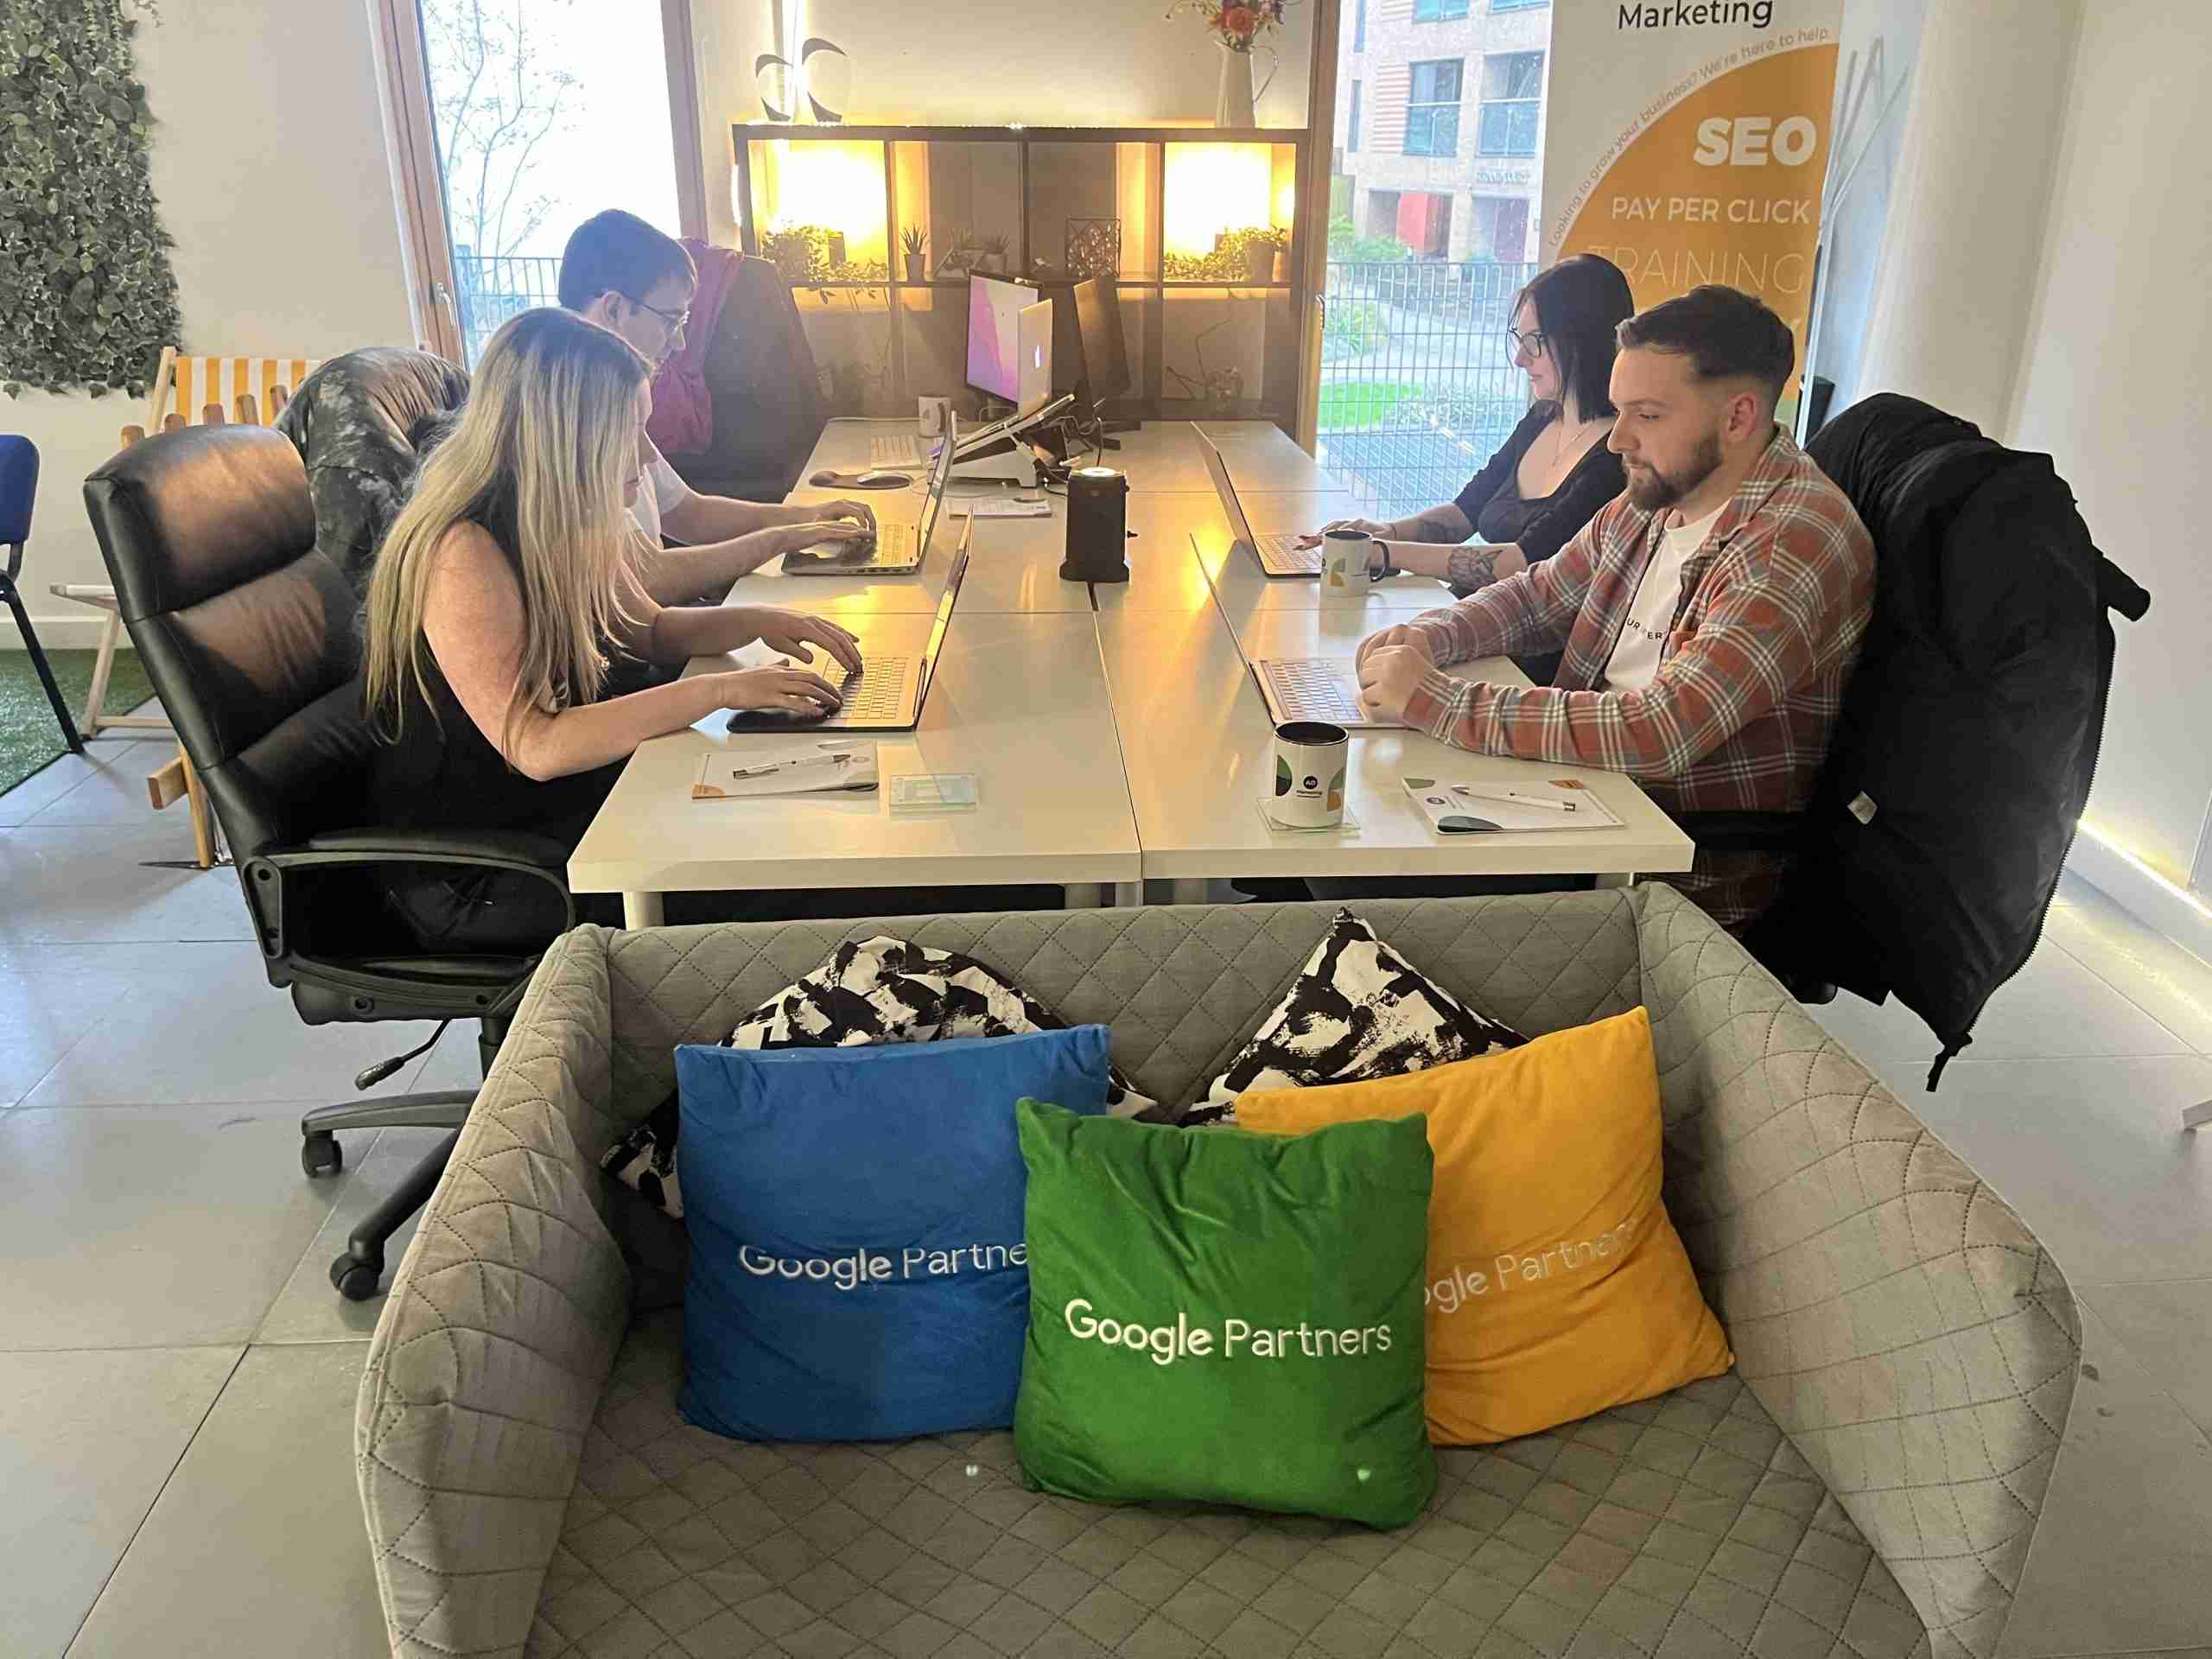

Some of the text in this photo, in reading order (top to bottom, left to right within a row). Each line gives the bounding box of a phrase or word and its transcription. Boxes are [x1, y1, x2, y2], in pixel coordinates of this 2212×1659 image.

[1618, 0, 1773, 29] Marketing
[1549, 195, 1582, 247] Looking
[1591, 147, 1615, 179] grow
[1615, 120, 1640, 151] your
[1742, 40, 1774, 59] here
[1779, 34, 1795, 48] to
[1797, 27, 1829, 43] help
[1694, 116, 1817, 167] SEO
[1611, 197, 1811, 225] PAY PER CLICK
[739, 1244, 893, 1291] Google
[1065, 1298, 1393, 1366] Google Partners
